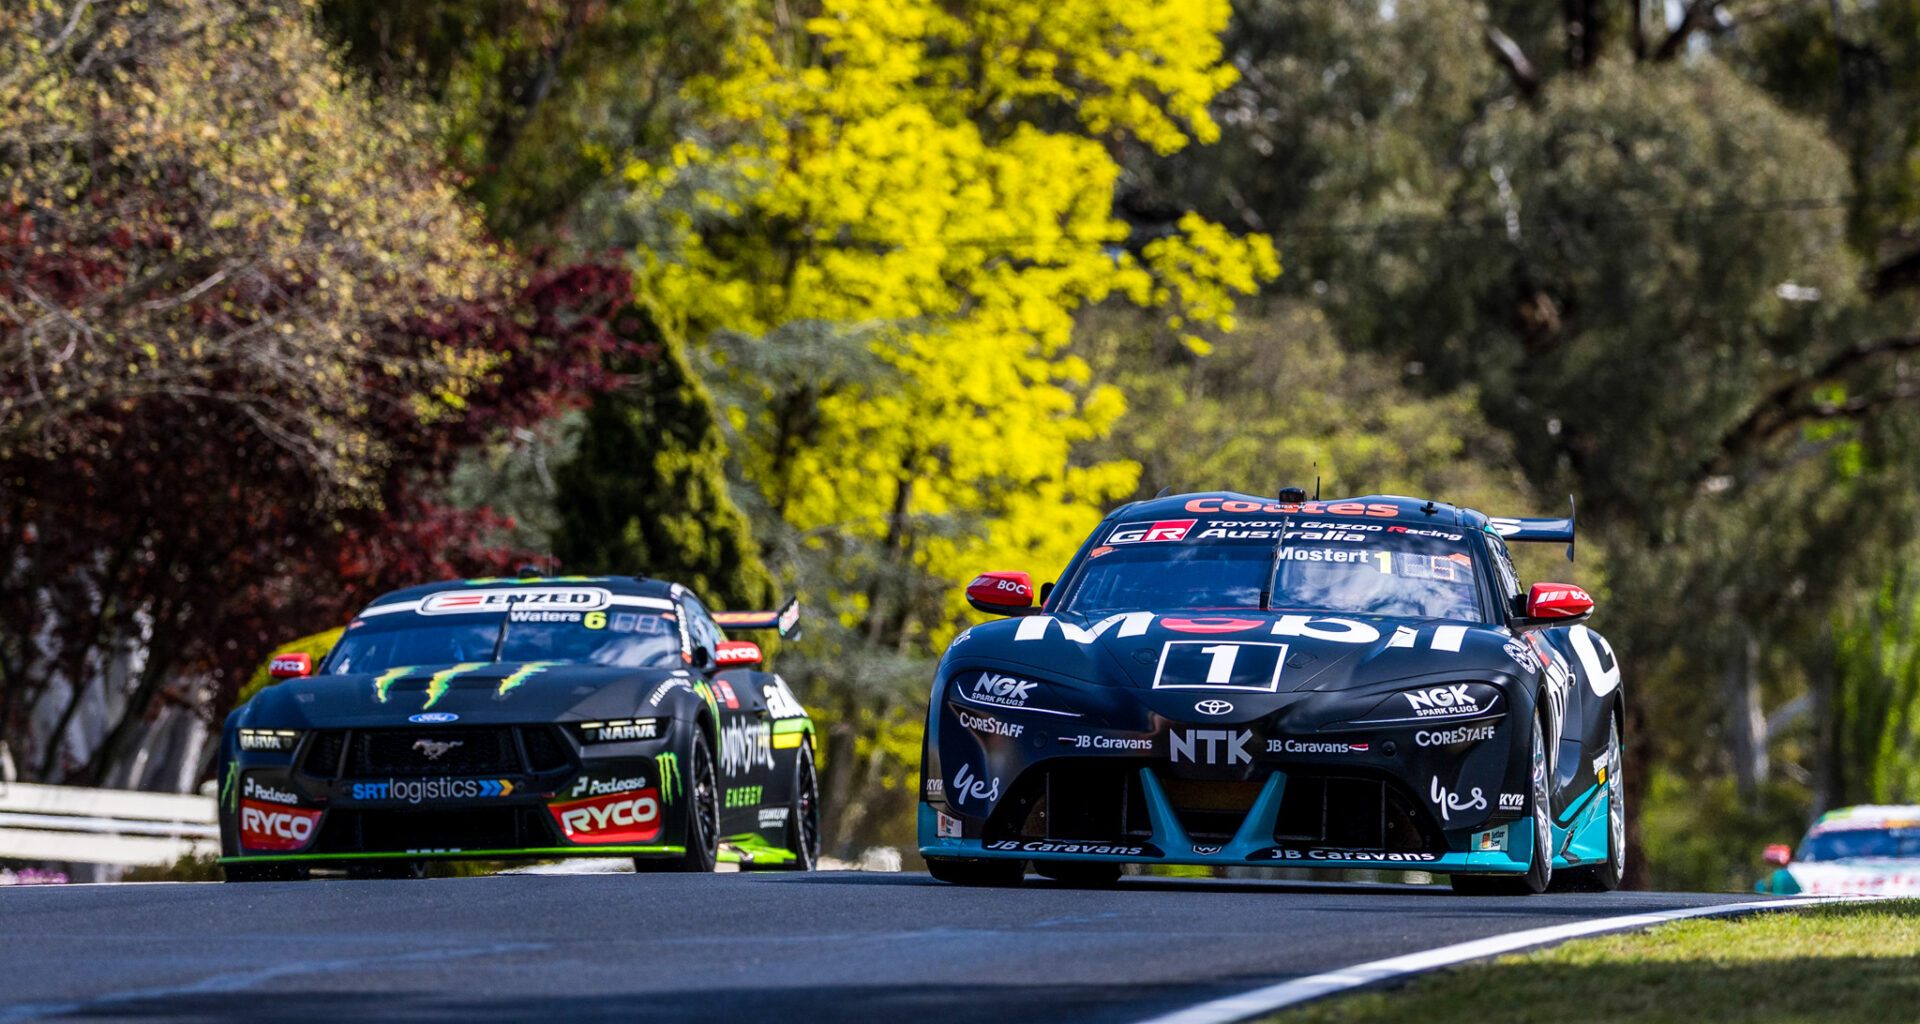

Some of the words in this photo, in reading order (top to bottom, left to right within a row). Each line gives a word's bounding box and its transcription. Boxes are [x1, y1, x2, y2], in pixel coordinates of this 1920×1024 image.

[1185, 498, 1398, 518] Coates
[1108, 528, 1186, 544] GR
[1197, 531, 1366, 546] Australia
[1207, 521, 1291, 532] TOYOTA
[1301, 523, 1382, 535] GAZOO
[1386, 527, 1463, 544] Racing
[1279, 547, 1369, 565] Mostert
[997, 579, 1028, 595] BOC
[484, 593, 592, 605] ENZED
[509, 611, 581, 623] Waters
[583, 611, 607, 630] 6
[1013, 611, 1469, 654] Mobil
[715, 647, 760, 661] RYCO
[1202, 645, 1244, 685] 1
[973, 671, 1038, 701] NGK
[970, 692, 997, 703] SPARK
[995, 696, 1025, 707] PLUGS
[1402, 683, 1476, 710] NGK
[1416, 707, 1448, 717] SPARK
[1448, 704, 1479, 714] PLUGS
[598, 724, 657, 741] NARVA
[1075, 735, 1091, 748] JB
[1094, 735, 1153, 750] Caravans
[1169, 728, 1253, 765] NTK
[1266, 739, 1283, 753] JB
[1285, 740, 1349, 753] Caravans
[725, 785, 763, 808] ENERGY
[1499, 792, 1525, 806] KYB
[242, 806, 313, 841] RYCO
[561, 797, 658, 837] RYCO
[986, 840, 1020, 851] JB
[1023, 841, 1143, 855] Caravans
[1271, 848, 1302, 859] JB
[1307, 849, 1436, 861] Caravans
